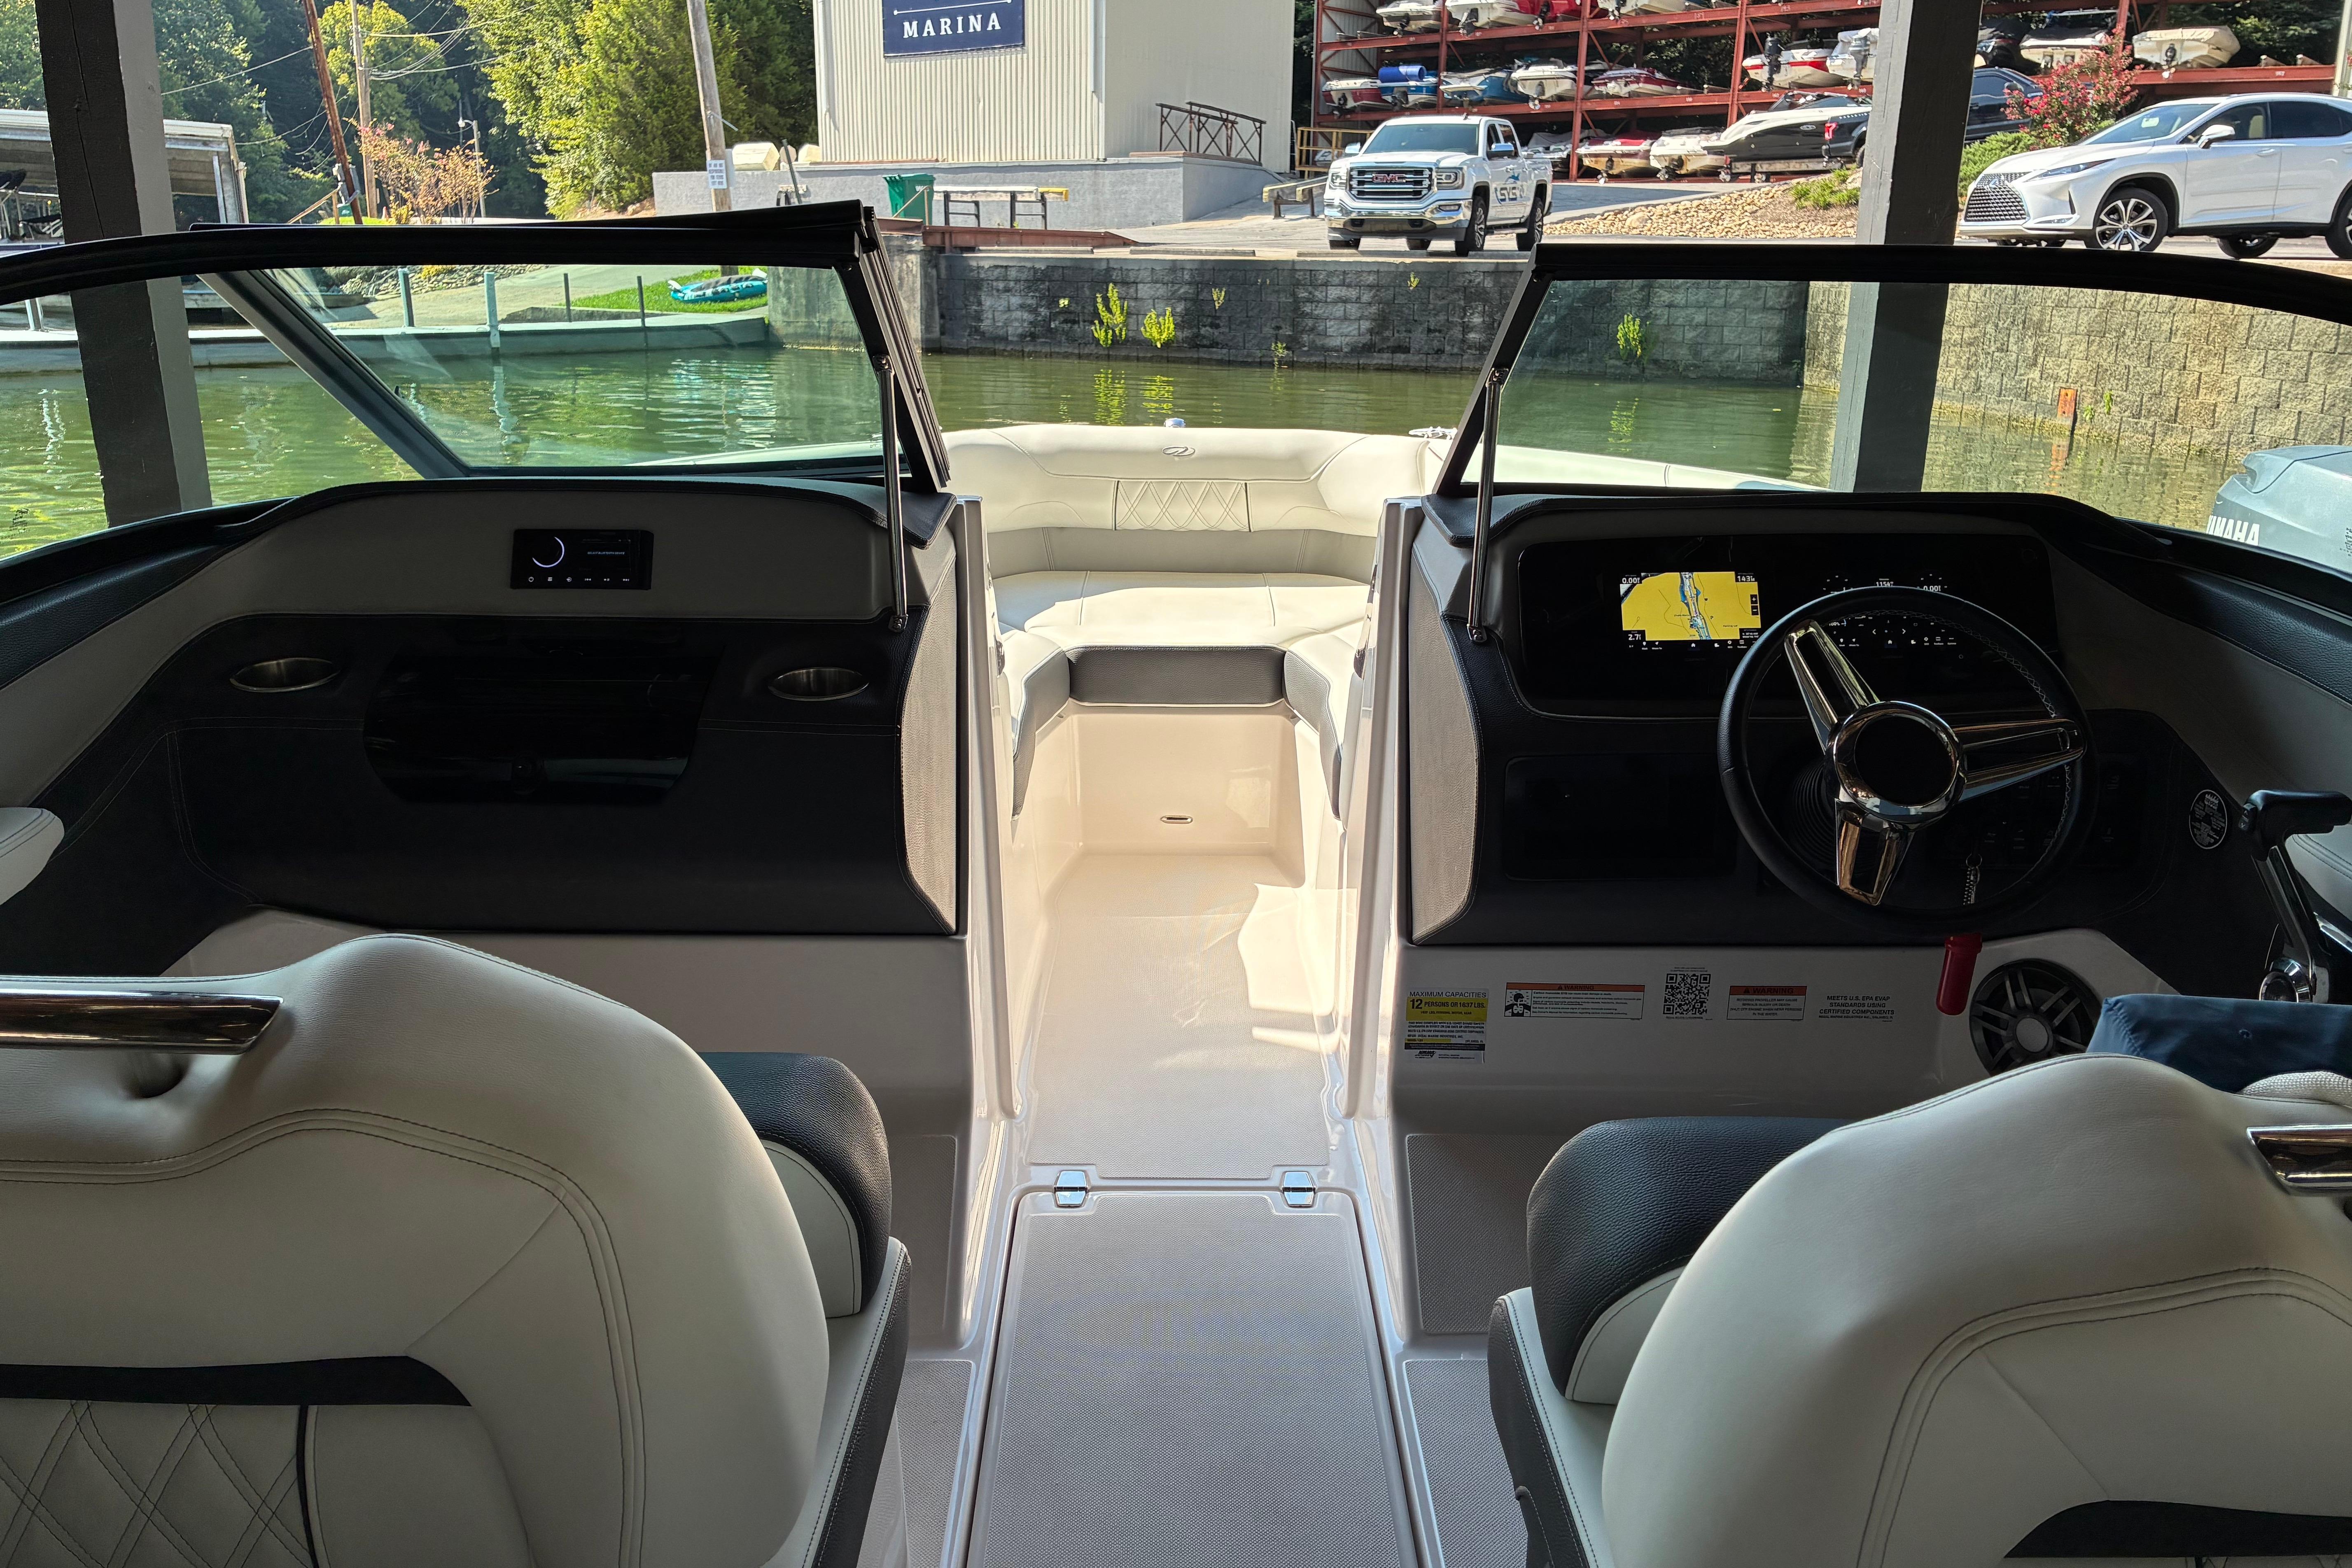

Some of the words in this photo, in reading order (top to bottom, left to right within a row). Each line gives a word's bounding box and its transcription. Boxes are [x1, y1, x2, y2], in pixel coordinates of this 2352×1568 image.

[903, 13, 1001, 38] MARINA
[1372, 173, 1406, 183] GMC
[2206, 515, 2260, 546] YAMAHA
[1410, 999, 1423, 1009] 12
